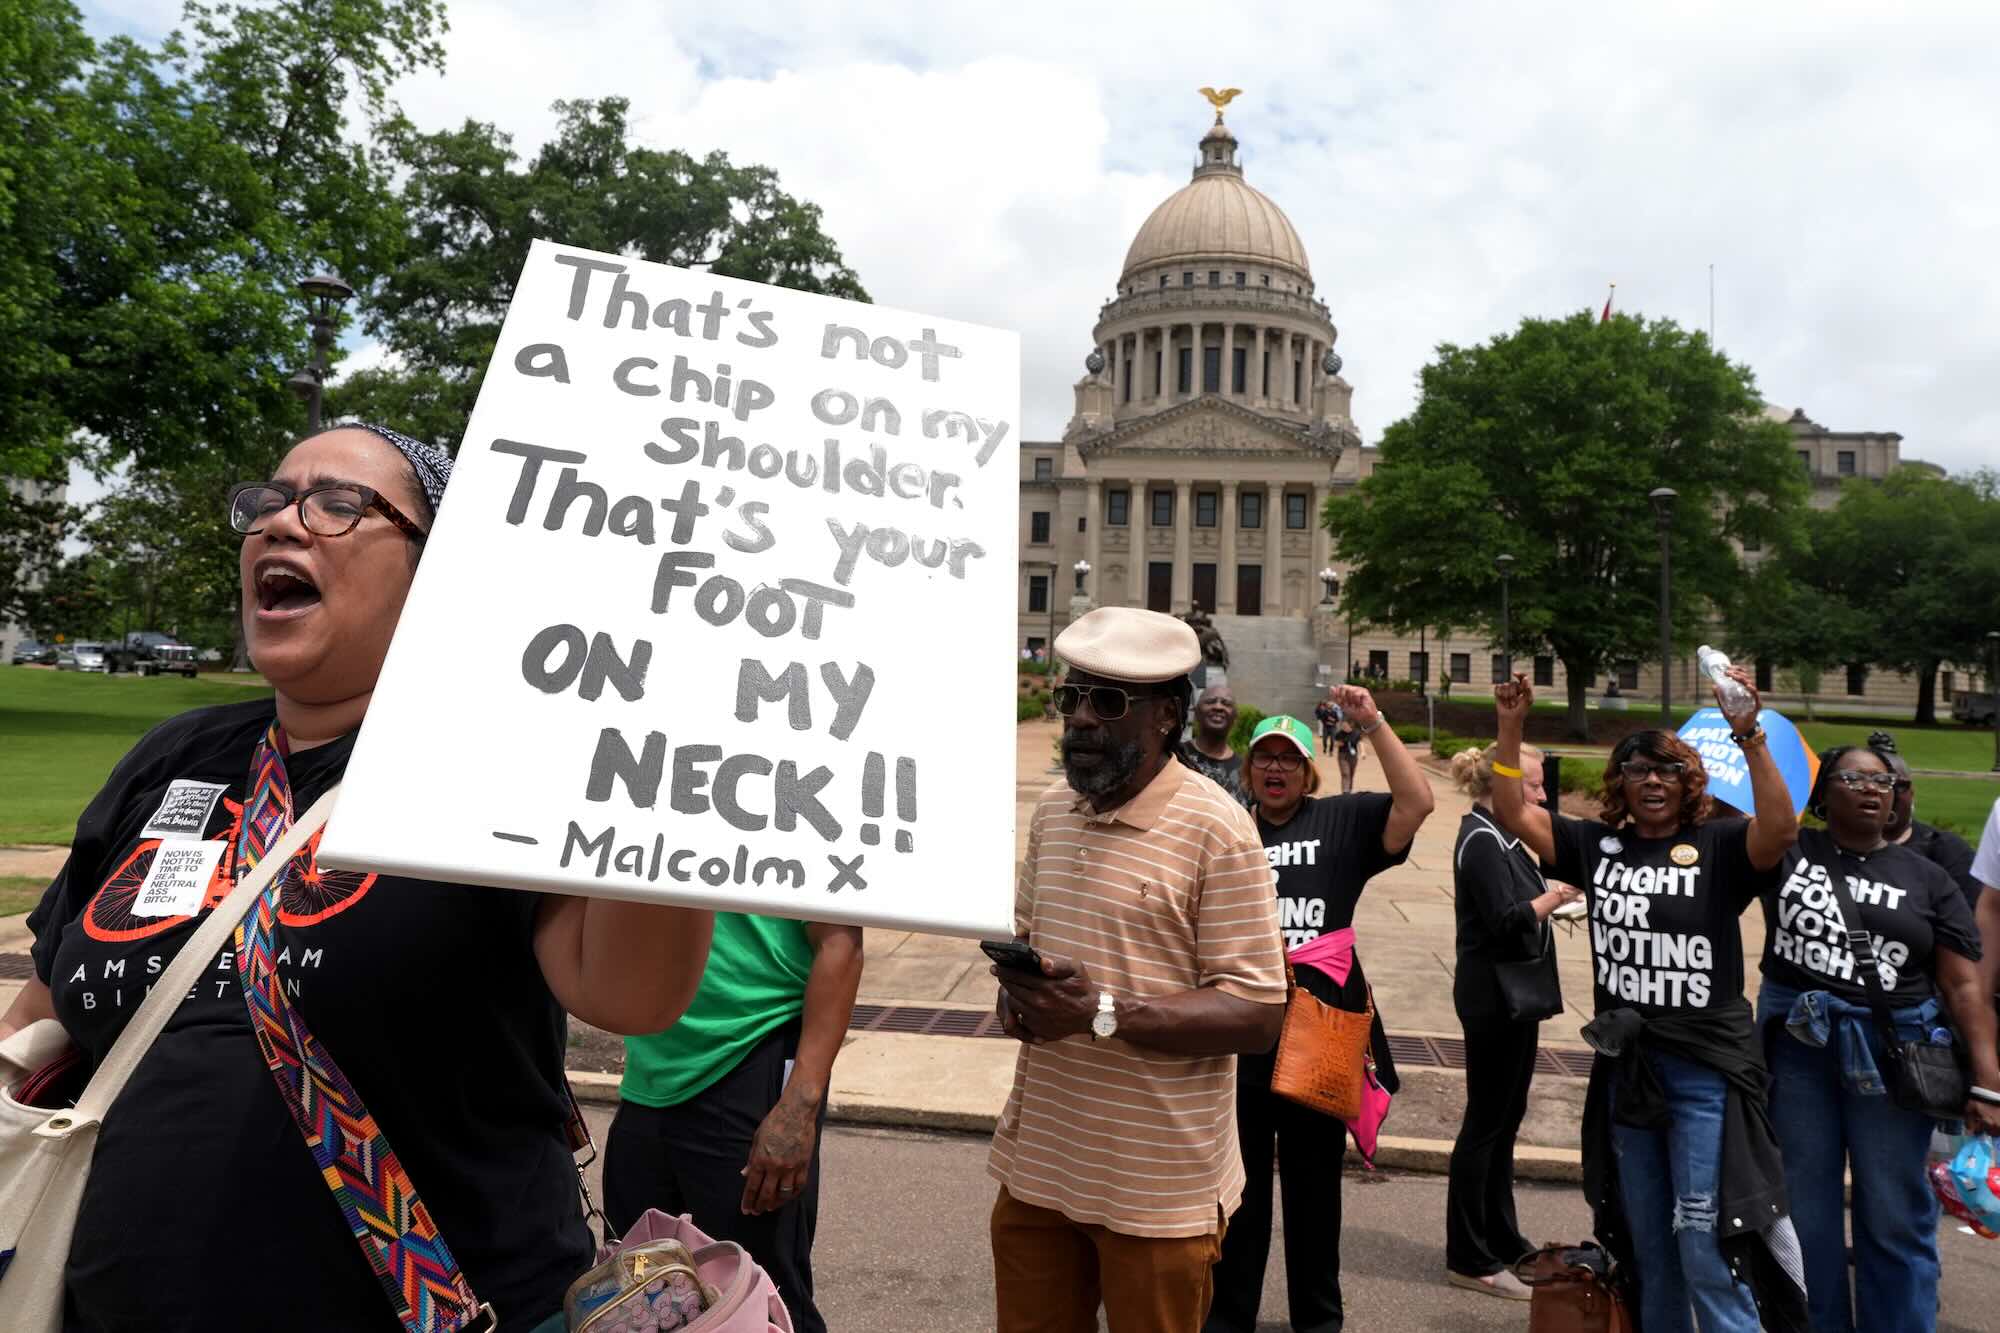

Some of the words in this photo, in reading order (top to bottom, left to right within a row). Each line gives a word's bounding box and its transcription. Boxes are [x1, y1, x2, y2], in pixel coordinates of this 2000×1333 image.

[555, 254, 779, 349] That's
[820, 323, 963, 382] not
[514, 343, 571, 385] a
[612, 355, 775, 422] chip
[810, 388, 901, 436] on
[921, 407, 1010, 468] my
[490, 438, 776, 554] That's
[825, 517, 986, 587] your
[650, 551, 856, 640] FOOT
[522, 623, 653, 703] ON
[734, 658, 876, 743] MY
[585, 727, 918, 854] NECK!!
[160, 865, 182, 873] TIME
[161, 858, 186, 866] NOT
[185, 857, 206, 865] THE
[164, 850, 192, 858] NOW
[193, 850, 203, 858] IS
[560, 820, 806, 889] Malcolm
[1264, 839, 1320, 866] GHT
[146, 888, 169, 896] ASS
[150, 880, 197, 888] NEUTRAL
[154, 873, 167, 881] BE
[1593, 857, 1610, 886] I
[1606, 861, 1700, 897] FIGHT
[143, 895, 177, 904] BITCH
[1592, 887, 1650, 929] FOR
[1592, 920, 1713, 970] VOTING
[1774, 927, 1898, 991] RIGHS
[70, 948, 323, 984] AMSEAM
